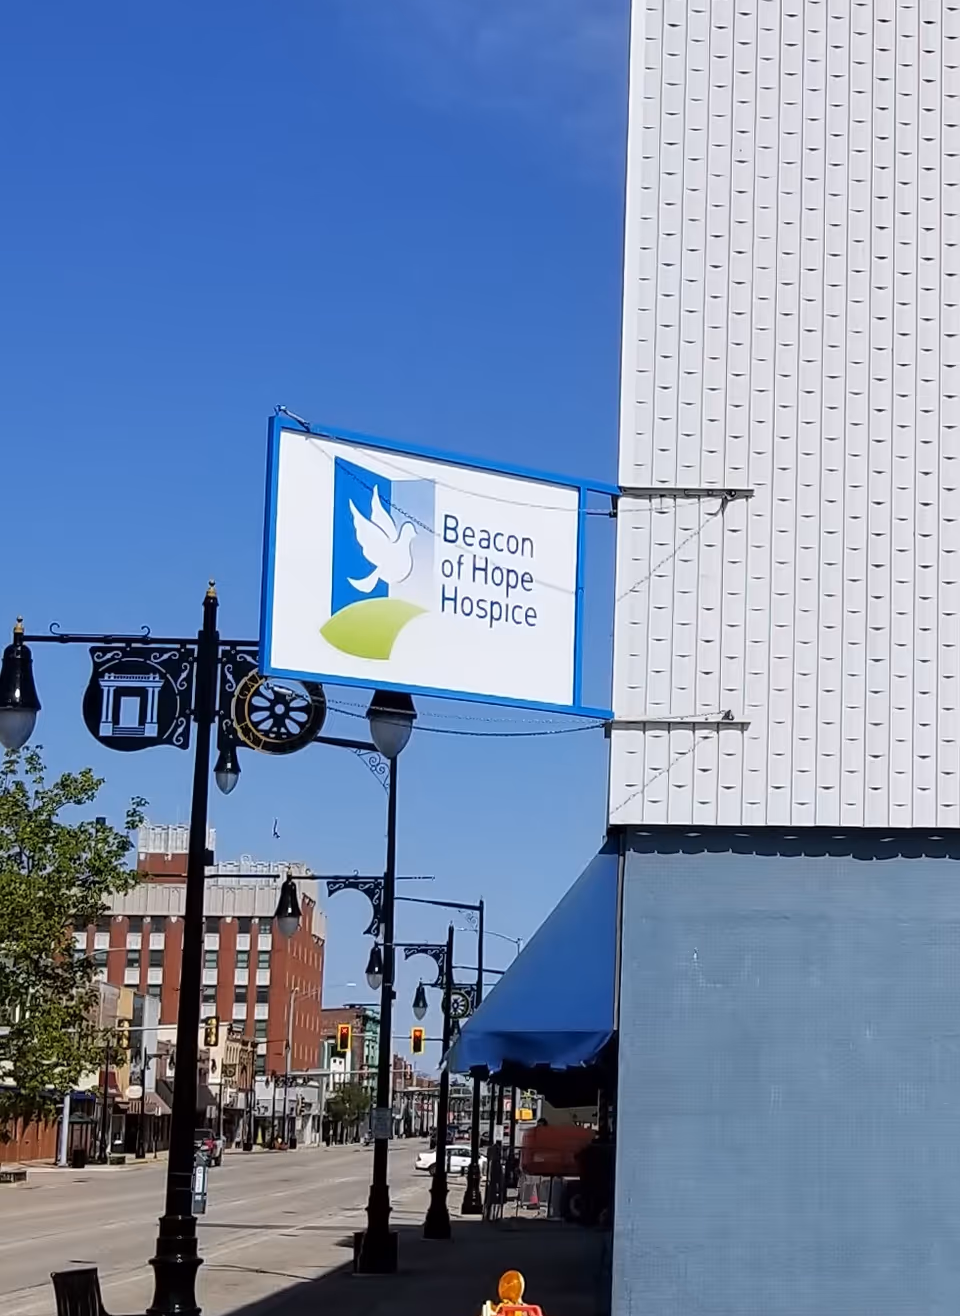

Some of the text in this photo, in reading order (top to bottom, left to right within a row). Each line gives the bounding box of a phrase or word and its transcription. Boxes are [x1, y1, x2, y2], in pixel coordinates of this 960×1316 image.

[443, 514, 534, 558] Beacon
[441, 554, 534, 598] of Hope
[441, 584, 538, 628] Hospice
